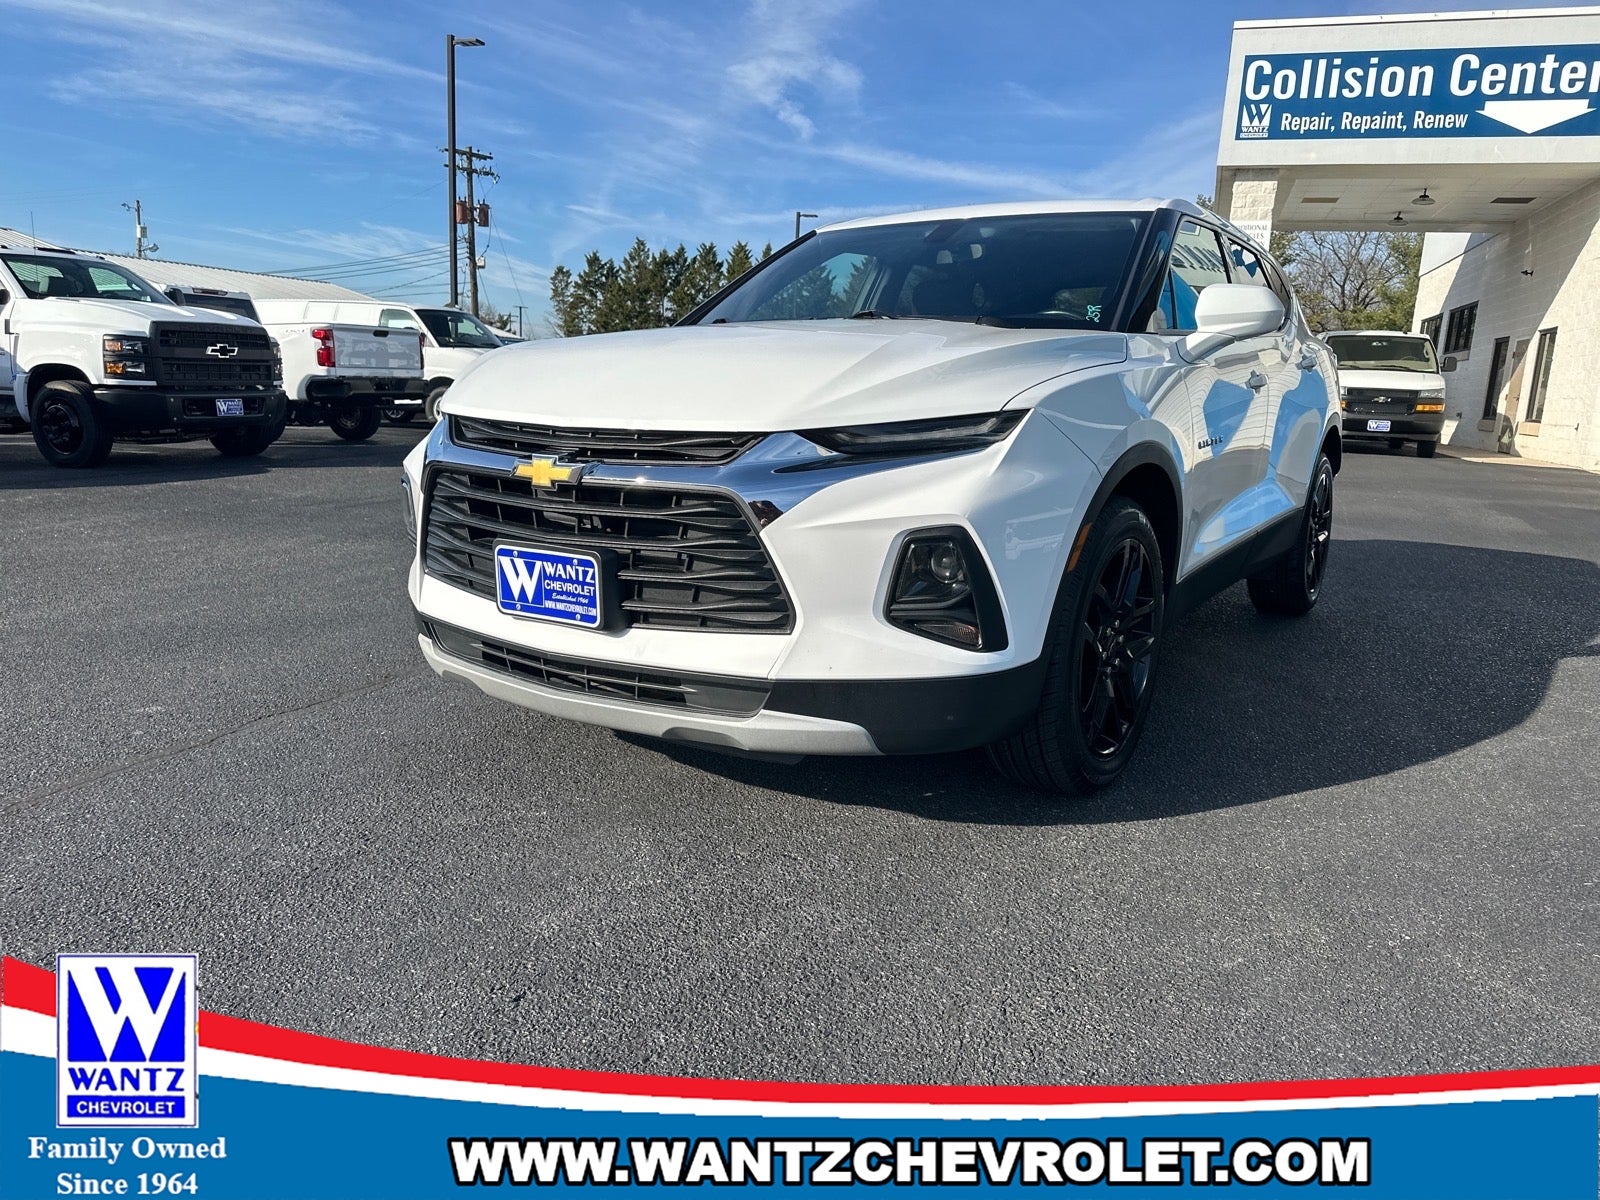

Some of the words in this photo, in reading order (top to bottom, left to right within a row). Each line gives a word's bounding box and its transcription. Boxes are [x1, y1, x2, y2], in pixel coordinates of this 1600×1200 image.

[1245, 57, 1434, 100] Collision
[1450, 53, 1600, 96] Center
[1280, 112, 1335, 134] Repair,
[1341, 111, 1407, 133] Repaint,
[1413, 110, 1469, 129] Renew
[542, 561, 595, 584] WANTZ
[544, 579, 595, 597] CHEVROLET
